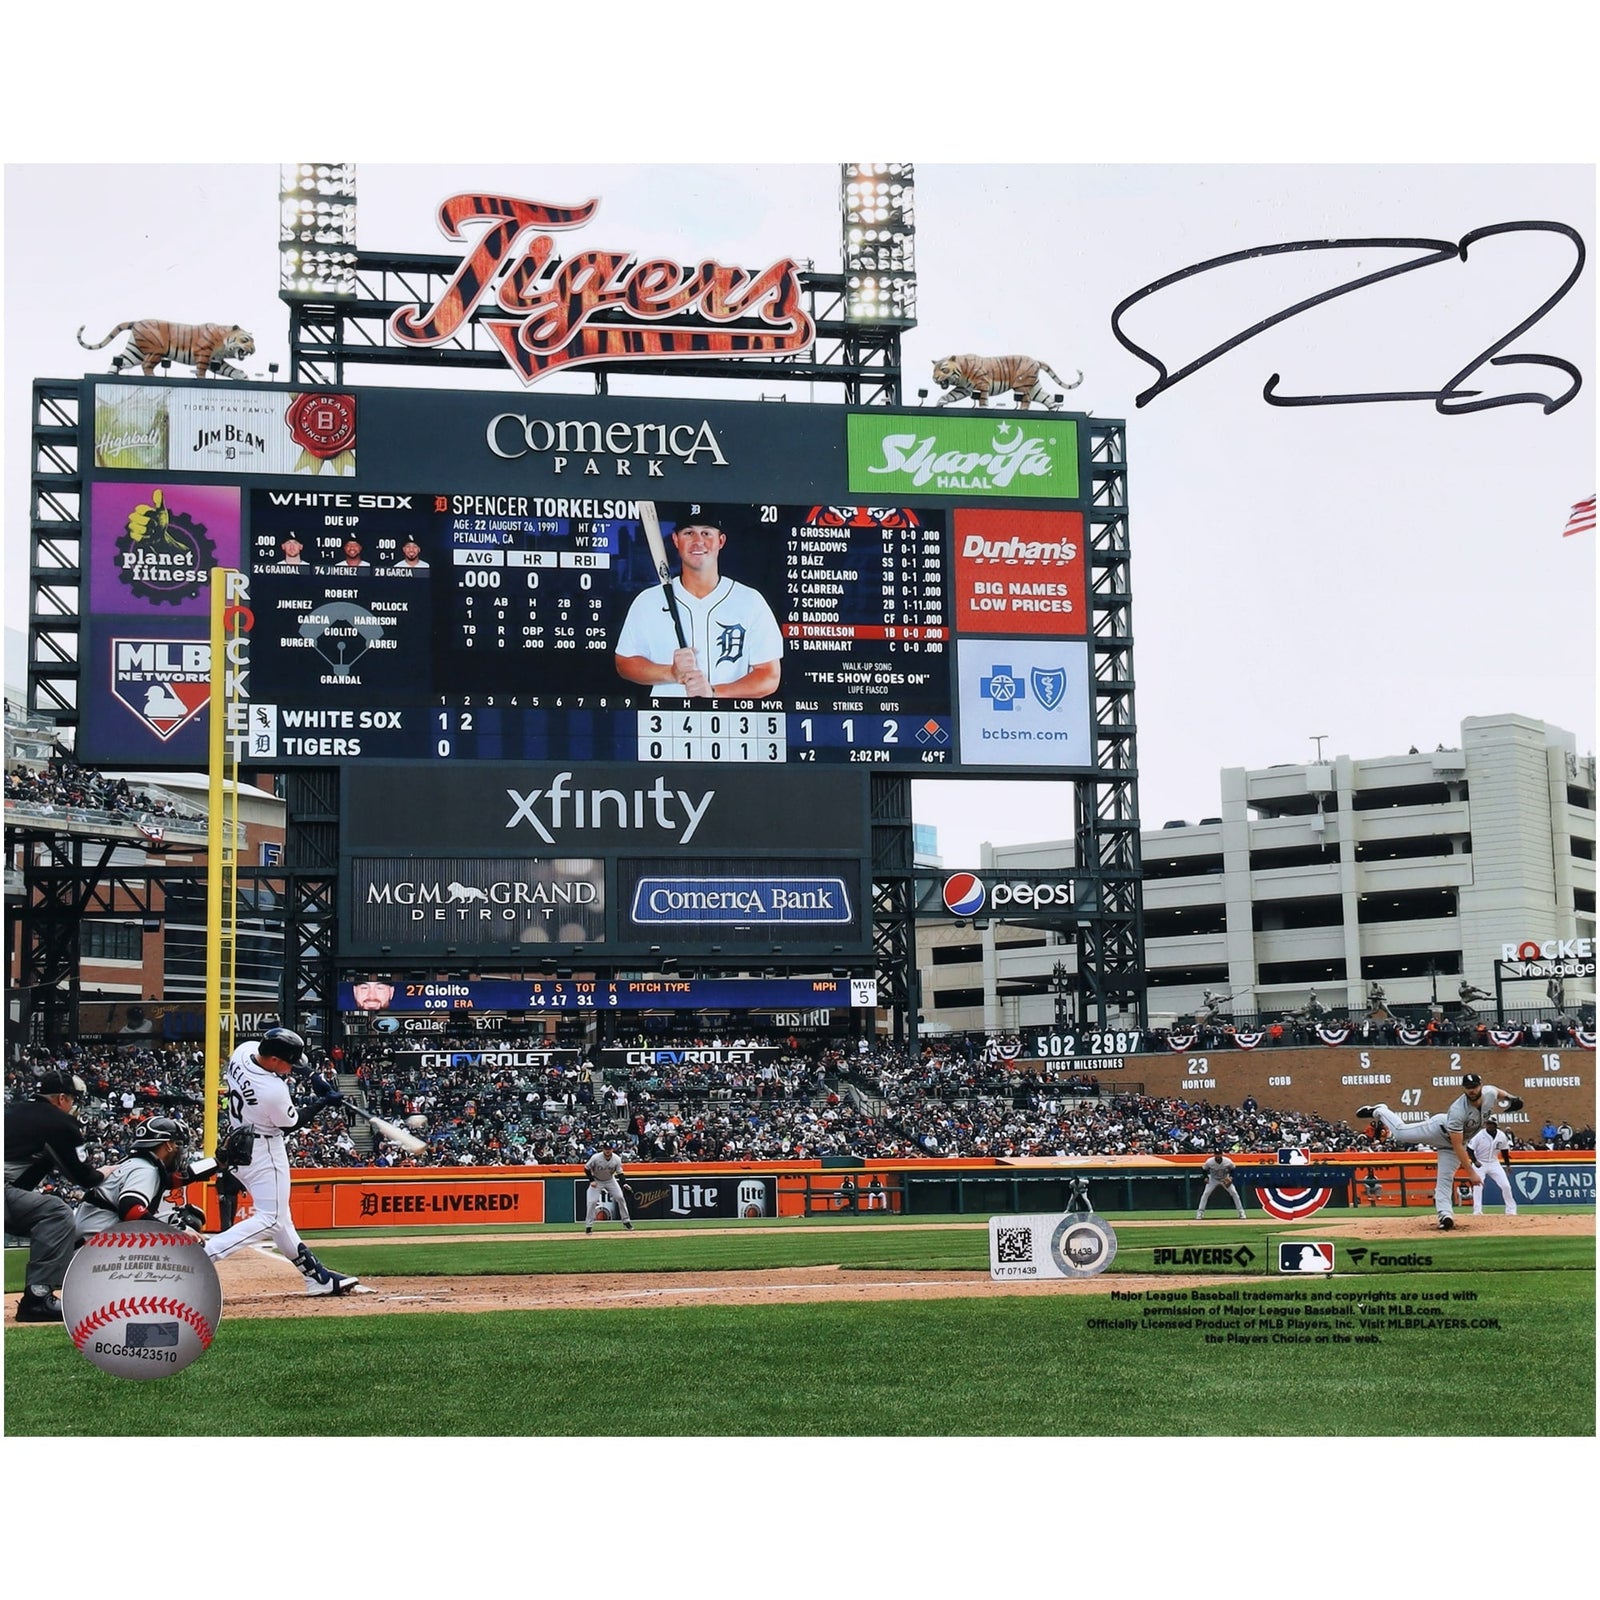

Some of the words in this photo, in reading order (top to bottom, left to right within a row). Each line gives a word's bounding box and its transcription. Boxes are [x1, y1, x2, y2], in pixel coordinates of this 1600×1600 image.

[389, 193, 816, 386] Tigers
[304, 400, 317, 414] JIM
[321, 398, 347, 416] BEAM
[302, 422, 327, 442] SINCE
[331, 424, 348, 442] 1795
[95, 429, 161, 456] Highball
[193, 429, 221, 452] JIM
[225, 424, 264, 453] BEAM
[868, 433, 1053, 487] Sharifa
[554, 457, 664, 477] PARK
[937, 476, 992, 489] HALAL
[269, 492, 352, 508] WHITE
[358, 495, 412, 509] SOX
[453, 496, 528, 517] SPENCER
[534, 498, 640, 520] TORKELSON
[761, 505, 777, 522] 20
[325, 516, 343, 526] DUE
[346, 516, 359, 526] UP
[454, 533, 500, 544] PETALUMA,
[801, 528, 850, 538] GROSSMAN
[801, 542, 847, 552] MEADOWS
[963, 536, 1076, 562] Dunham's
[123, 549, 193, 569] planet
[466, 553, 493, 563] AVG
[574, 556, 596, 566] RBI
[802, 554, 824, 566] BÁEZ
[133, 565, 208, 582] fitness
[266, 565, 300, 574] GRANDAL
[326, 566, 357, 576] JIMENEZ
[387, 568, 412, 577] GARCIA
[802, 570, 858, 580] CANDELARIO
[325, 589, 358, 598] ROBERT
[802, 584, 844, 595] CABRERA
[974, 582, 1003, 595] BIG
[1009, 583, 1067, 597] NAMES
[277, 600, 312, 609] JIMENEZ
[371, 602, 408, 611] POLLOCK
[802, 598, 838, 608] SCHOOP
[970, 598, 1008, 611] LOW
[1012, 599, 1073, 613] PRICES
[298, 615, 330, 625] GARCIA
[354, 617, 397, 626] HARRISON
[803, 613, 839, 622] BADDOO
[324, 628, 358, 636] GIOLITO
[803, 627, 854, 637] TORKELSON
[281, 638, 314, 647] BURGER
[369, 640, 397, 649] ABREU
[803, 641, 852, 651] BARNHART
[118, 644, 211, 672] MLB
[223, 574, 255, 762] ROCKET
[842, 663, 873, 671] WALK-UP
[875, 663, 892, 671] SONG
[118, 672, 211, 682] NETWORK
[320, 675, 362, 685] GRANDAL
[805, 673, 834, 682] "THE
[837, 673, 873, 683] SHOW
[875, 674, 904, 684] GOES
[907, 674, 930, 684] ON"
[848, 686, 864, 694] LUPE
[866, 686, 888, 694] FIASCO
[796, 702, 818, 711] BALLS
[833, 702, 863, 711] STRIKES
[880, 702, 899, 712] OUTS
[283, 711, 353, 729] WHITE
[360, 712, 402, 729] SOX
[982, 727, 1068, 742] bcbsm.com
[283, 738, 361, 756] TIGERS
[850, 751, 872, 762] 2:02
[874, 751, 890, 762] PM
[921, 751, 945, 763] 46°F
[505, 772, 715, 844] xfinity
[367, 882, 444, 905] MGM
[771, 887, 834, 910] Bank
[992, 880, 1074, 909] pepsi
[411, 909, 554, 920] DETROIT
[1502, 938, 1596, 962] ROCKE
[1520, 963, 1595, 977] Mortgage
[406, 985, 424, 996] 27
[425, 985, 469, 996] Giolito
[629, 982, 661, 992] PITCH
[664, 982, 691, 993] TYPE
[813, 982, 837, 991] MPH
[852, 981, 875, 991] MVR
[859, 990, 869, 1004] 5
[454, 1000, 473, 1008] ERA
[476, 1018, 503, 1030] EXIT
[1038, 1035, 1075, 1056] 502
[1091, 1032, 1139, 1054] 2987
[421, 1053, 553, 1067] CHEVROLET
[627, 1051, 754, 1065] CHEVROLET
[1074, 1058, 1123, 1069] MILESTONES
[1360, 1053, 1371, 1069] 5
[1450, 1053, 1461, 1070] 2
[1542, 1053, 1560, 1071] 16
[1188, 1058, 1208, 1074] 23
[1182, 1079, 1215, 1089] HORTON
[1269, 1076, 1291, 1086] COBB
[1342, 1074, 1392, 1086] GREENBERG
[1524, 1077, 1581, 1087] NEWHOUSER
[1401, 1089, 1421, 1106] 47
[1548, 1173, 1596, 1187] FAND
[634, 1190, 670, 1208] Miller
[669, 1184, 718, 1214] Lite
[741, 1186, 765, 1204] Lite
[360, 1192, 519, 1218] DEEEE-LIVERED!
[1008, 1266, 1037, 1275] 071439
